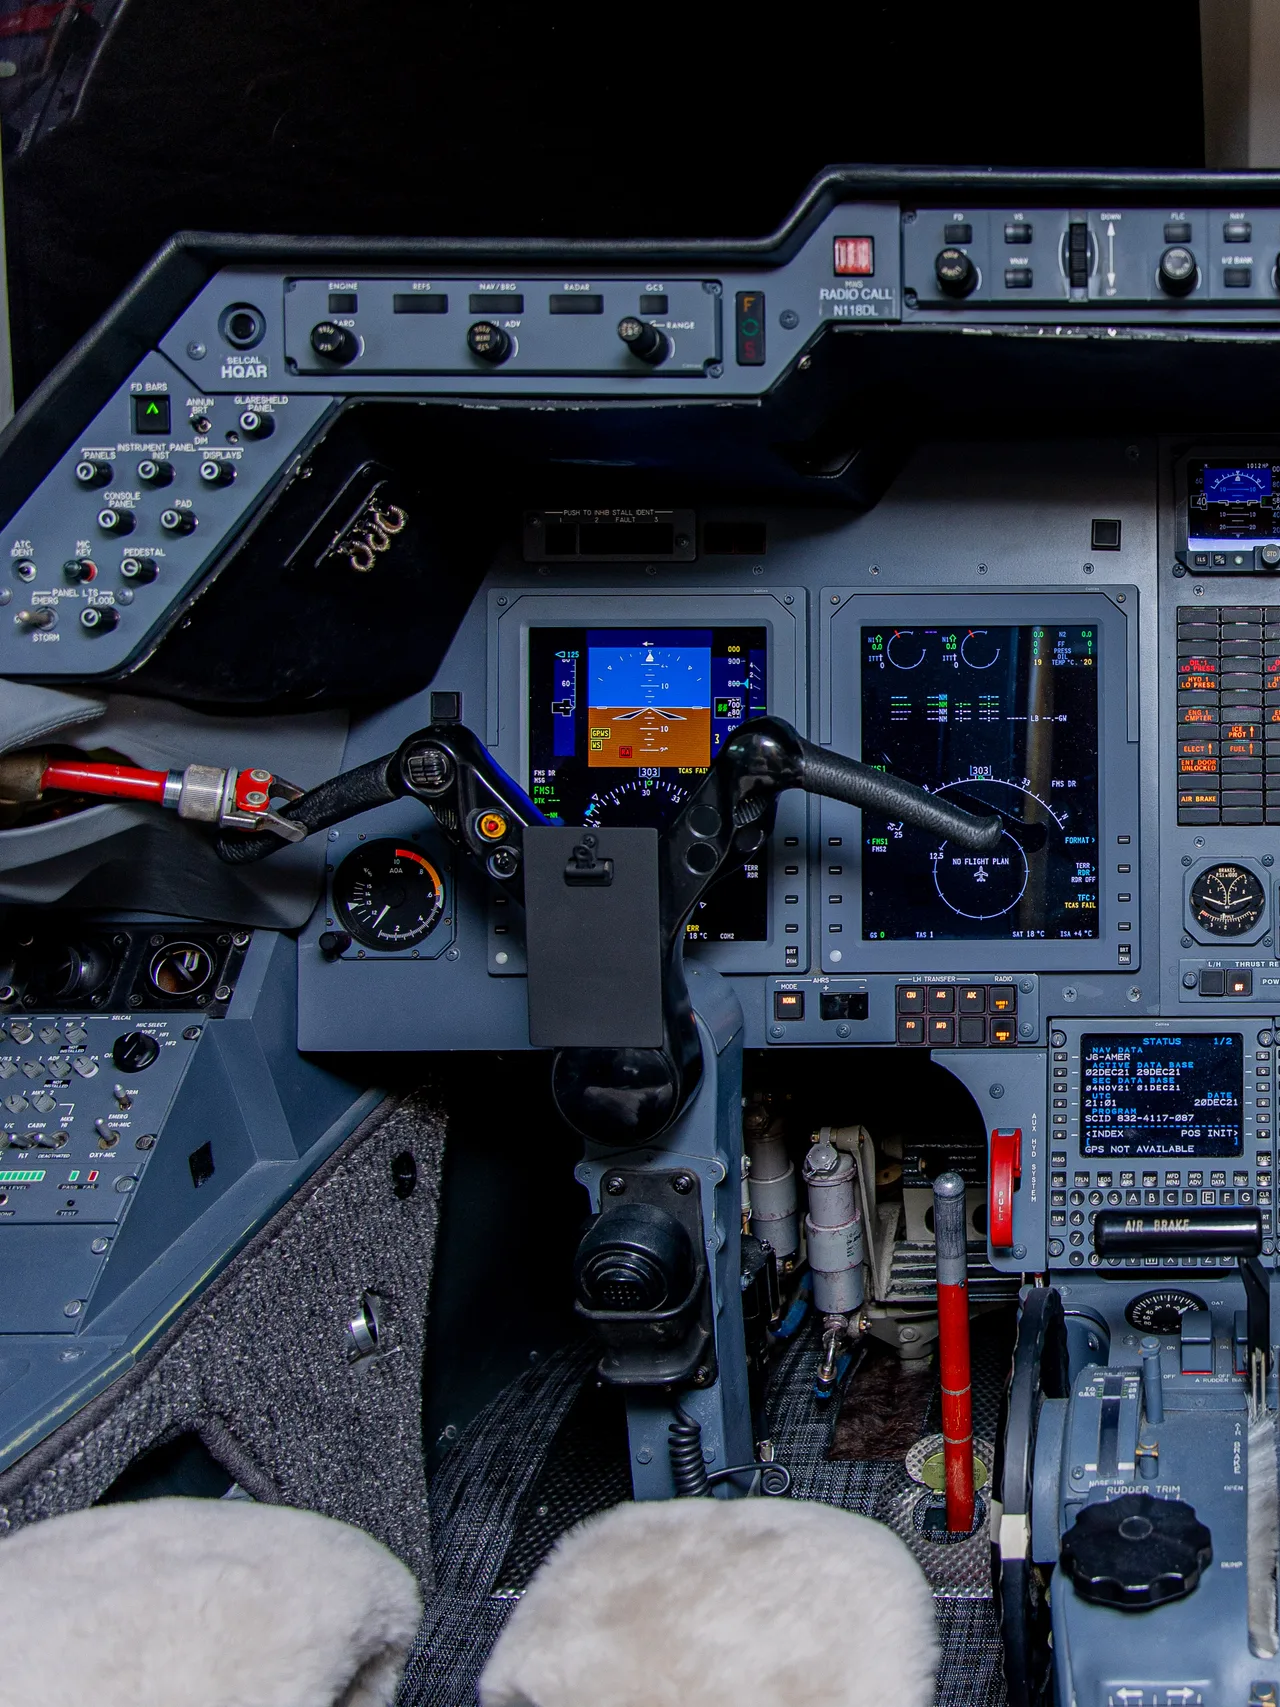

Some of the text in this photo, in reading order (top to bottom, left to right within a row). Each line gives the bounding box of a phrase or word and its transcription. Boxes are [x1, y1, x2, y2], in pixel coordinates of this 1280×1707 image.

[328, 282, 357, 290] ENGINE
[563, 283, 590, 291] RADAR
[819, 288, 893, 300] RADIO CALL
[834, 304, 879, 316] N118DL
[226, 356, 261, 364] SELCAL
[221, 364, 267, 378] HQAR
[233, 396, 288, 405] GLARESHIELD
[246, 403, 275, 412] PANEL
[117, 443, 196, 452] INSTRUMENT PANEL
[83, 451, 116, 460] PANELS
[202, 451, 242, 460] DISPLAYS
[103, 491, 141, 501] CONSOLE
[108, 499, 136, 508] PANEL
[123, 548, 166, 557] PEDESTAL
[32, 633, 60, 642] STORM
[642, 768, 658, 776] 303
[972, 766, 989, 775] 303
[534, 786, 554, 795] FMS1
[1065, 836, 1090, 844] FORMAT
[1143, 1037, 1232, 1046] STATUS 1/2
[1118, 1046, 1143, 1054] DATA
[1085, 1145, 1194, 1153] GPS NOT AVAILABLE
[1123, 1219, 1191, 1233] AIR BRAKE
[1106, 1485, 1180, 1495] RUDDER TRIM
